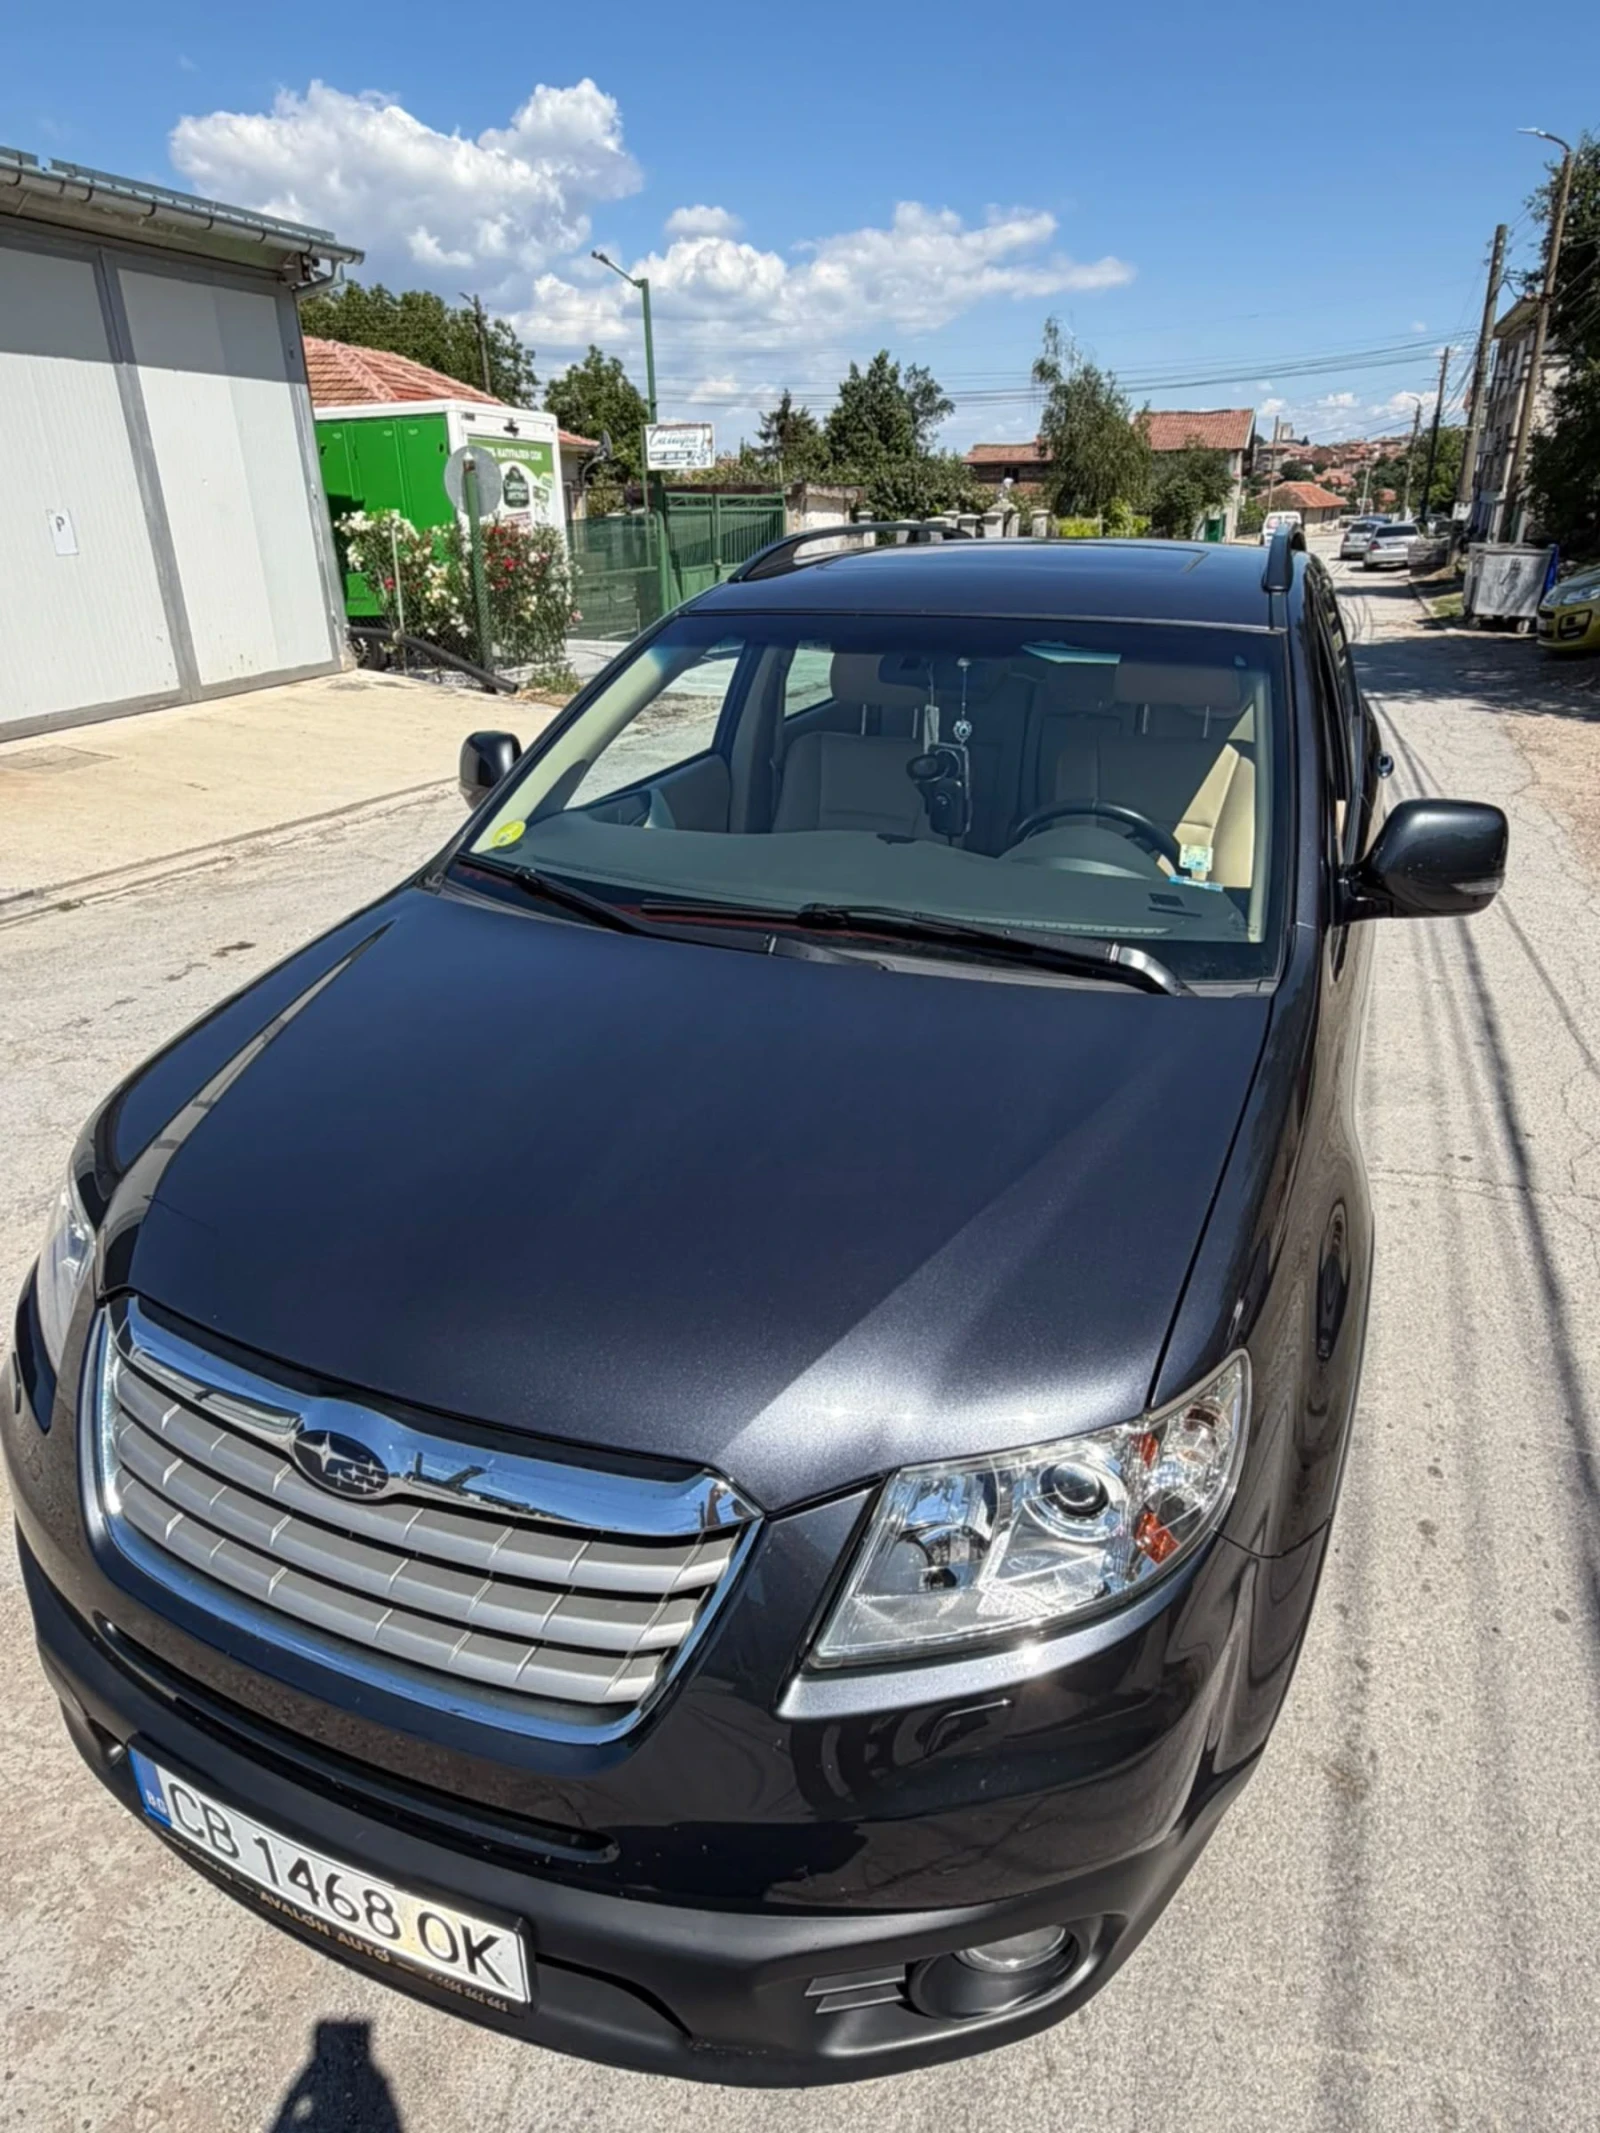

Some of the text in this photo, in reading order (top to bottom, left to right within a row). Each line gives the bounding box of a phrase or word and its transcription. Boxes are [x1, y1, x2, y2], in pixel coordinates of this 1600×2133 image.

[145, 1789, 168, 1814] BG
[168, 1782, 240, 1859] CB
[252, 1836, 402, 1940] 1468
[417, 1911, 512, 1988] OK
[259, 1891, 390, 1963] AVALON AUTO
